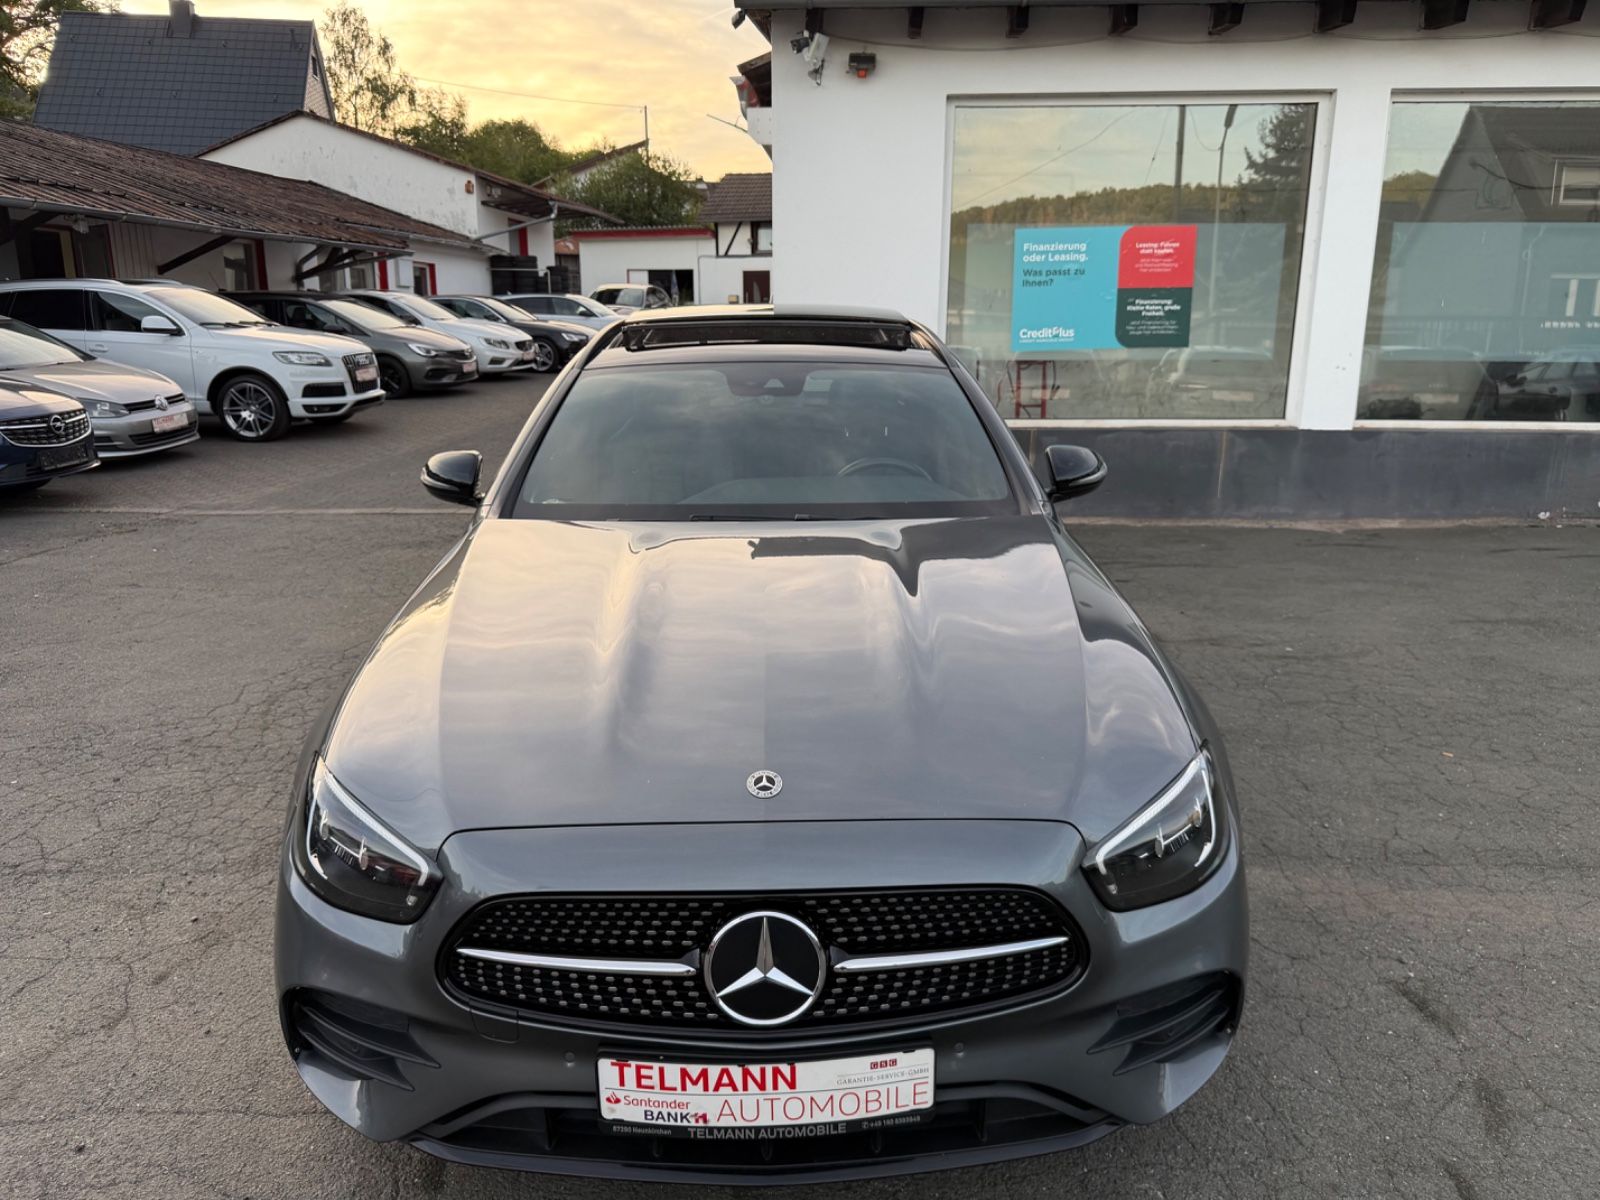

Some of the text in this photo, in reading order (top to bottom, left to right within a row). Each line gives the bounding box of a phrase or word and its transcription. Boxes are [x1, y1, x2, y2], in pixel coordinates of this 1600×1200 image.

[1023, 242, 1087, 252] Finanzierung
[1023, 252, 1088, 262] oder Leasing.
[1023, 268, 1043, 277] Was
[1045, 268, 1071, 277] passt
[1022, 279, 1053, 287] Ihnen?
[1019, 326, 1075, 338] CreditPlus
[610, 1061, 797, 1092] TELMANN
[623, 1095, 690, 1110] Santander
[717, 1081, 929, 1123] AUTOMOBILE
[688, 1123, 847, 1140] TELMANN AUTOMOBILE
